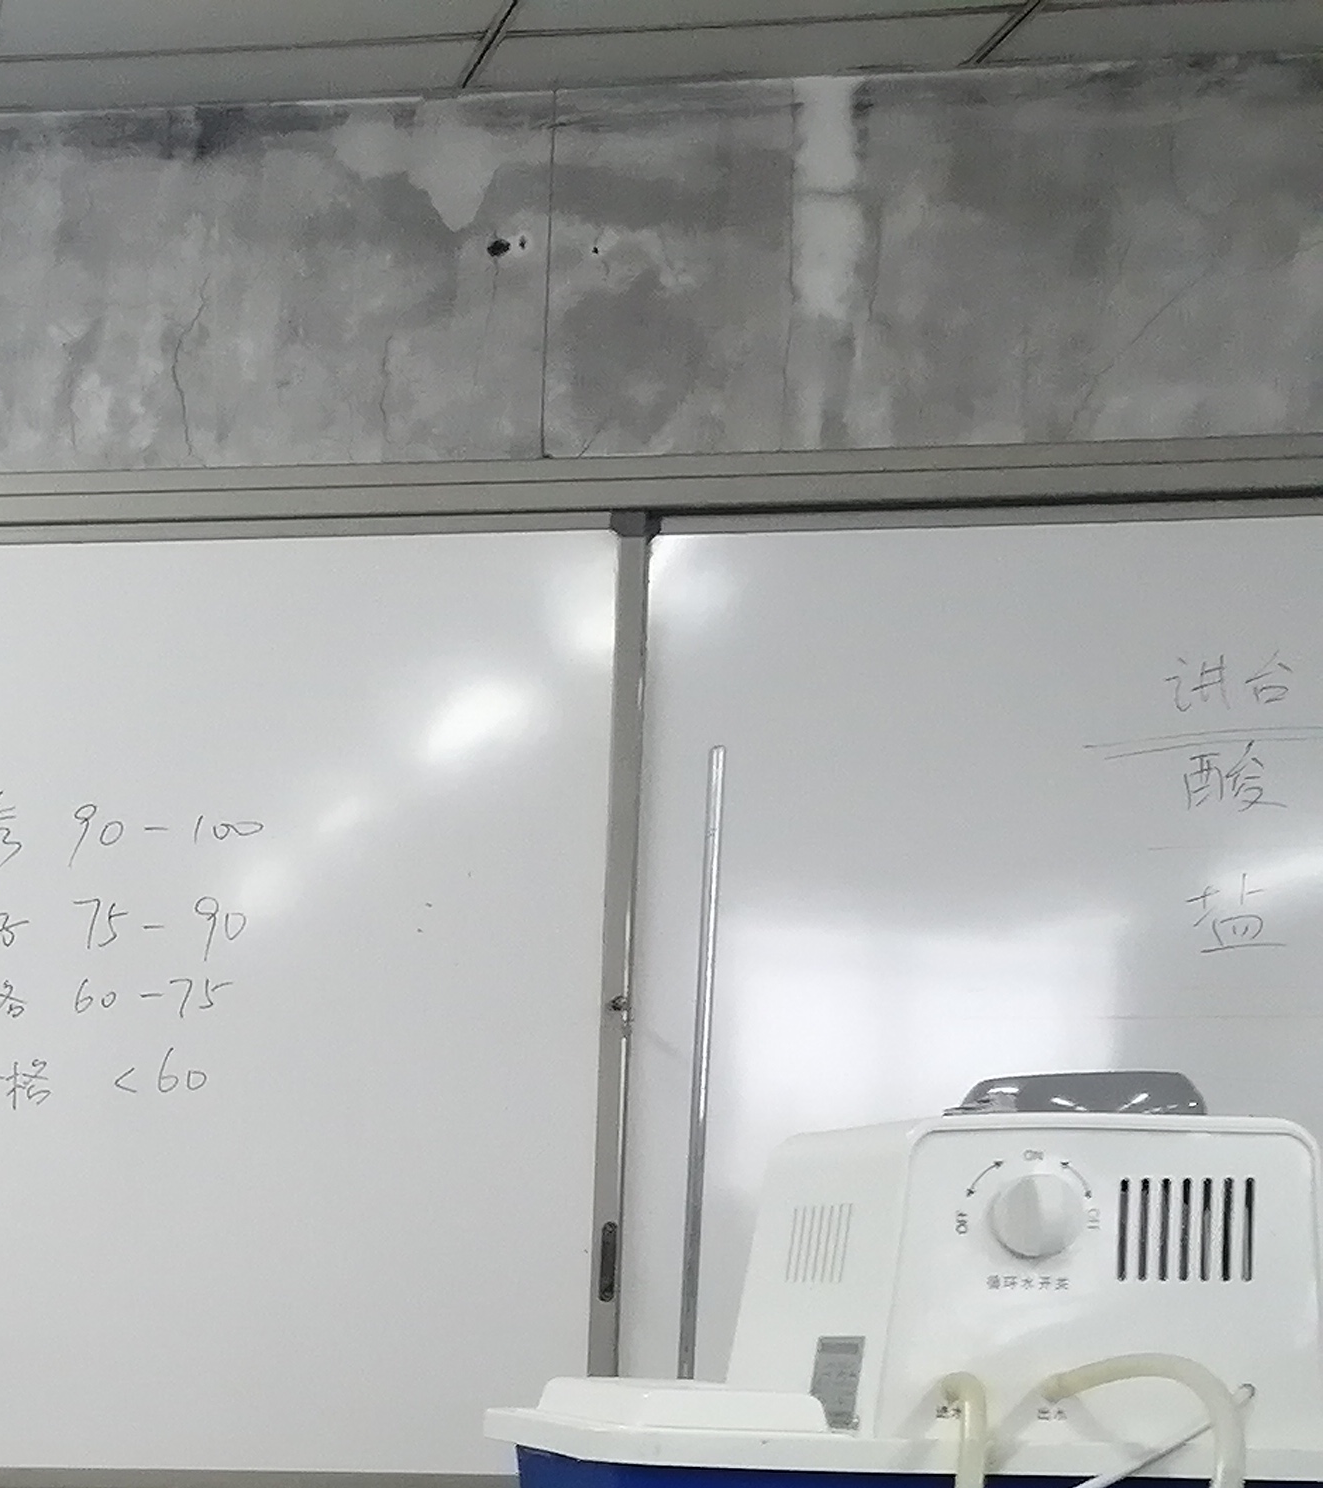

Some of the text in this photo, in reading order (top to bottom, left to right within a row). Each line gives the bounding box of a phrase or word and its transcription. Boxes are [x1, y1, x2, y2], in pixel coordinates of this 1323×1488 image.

[1164, 650, 1294, 713] 讲台
[1183, 740, 1288, 813] 酸
[1186, 873, 1288, 954] 盐
